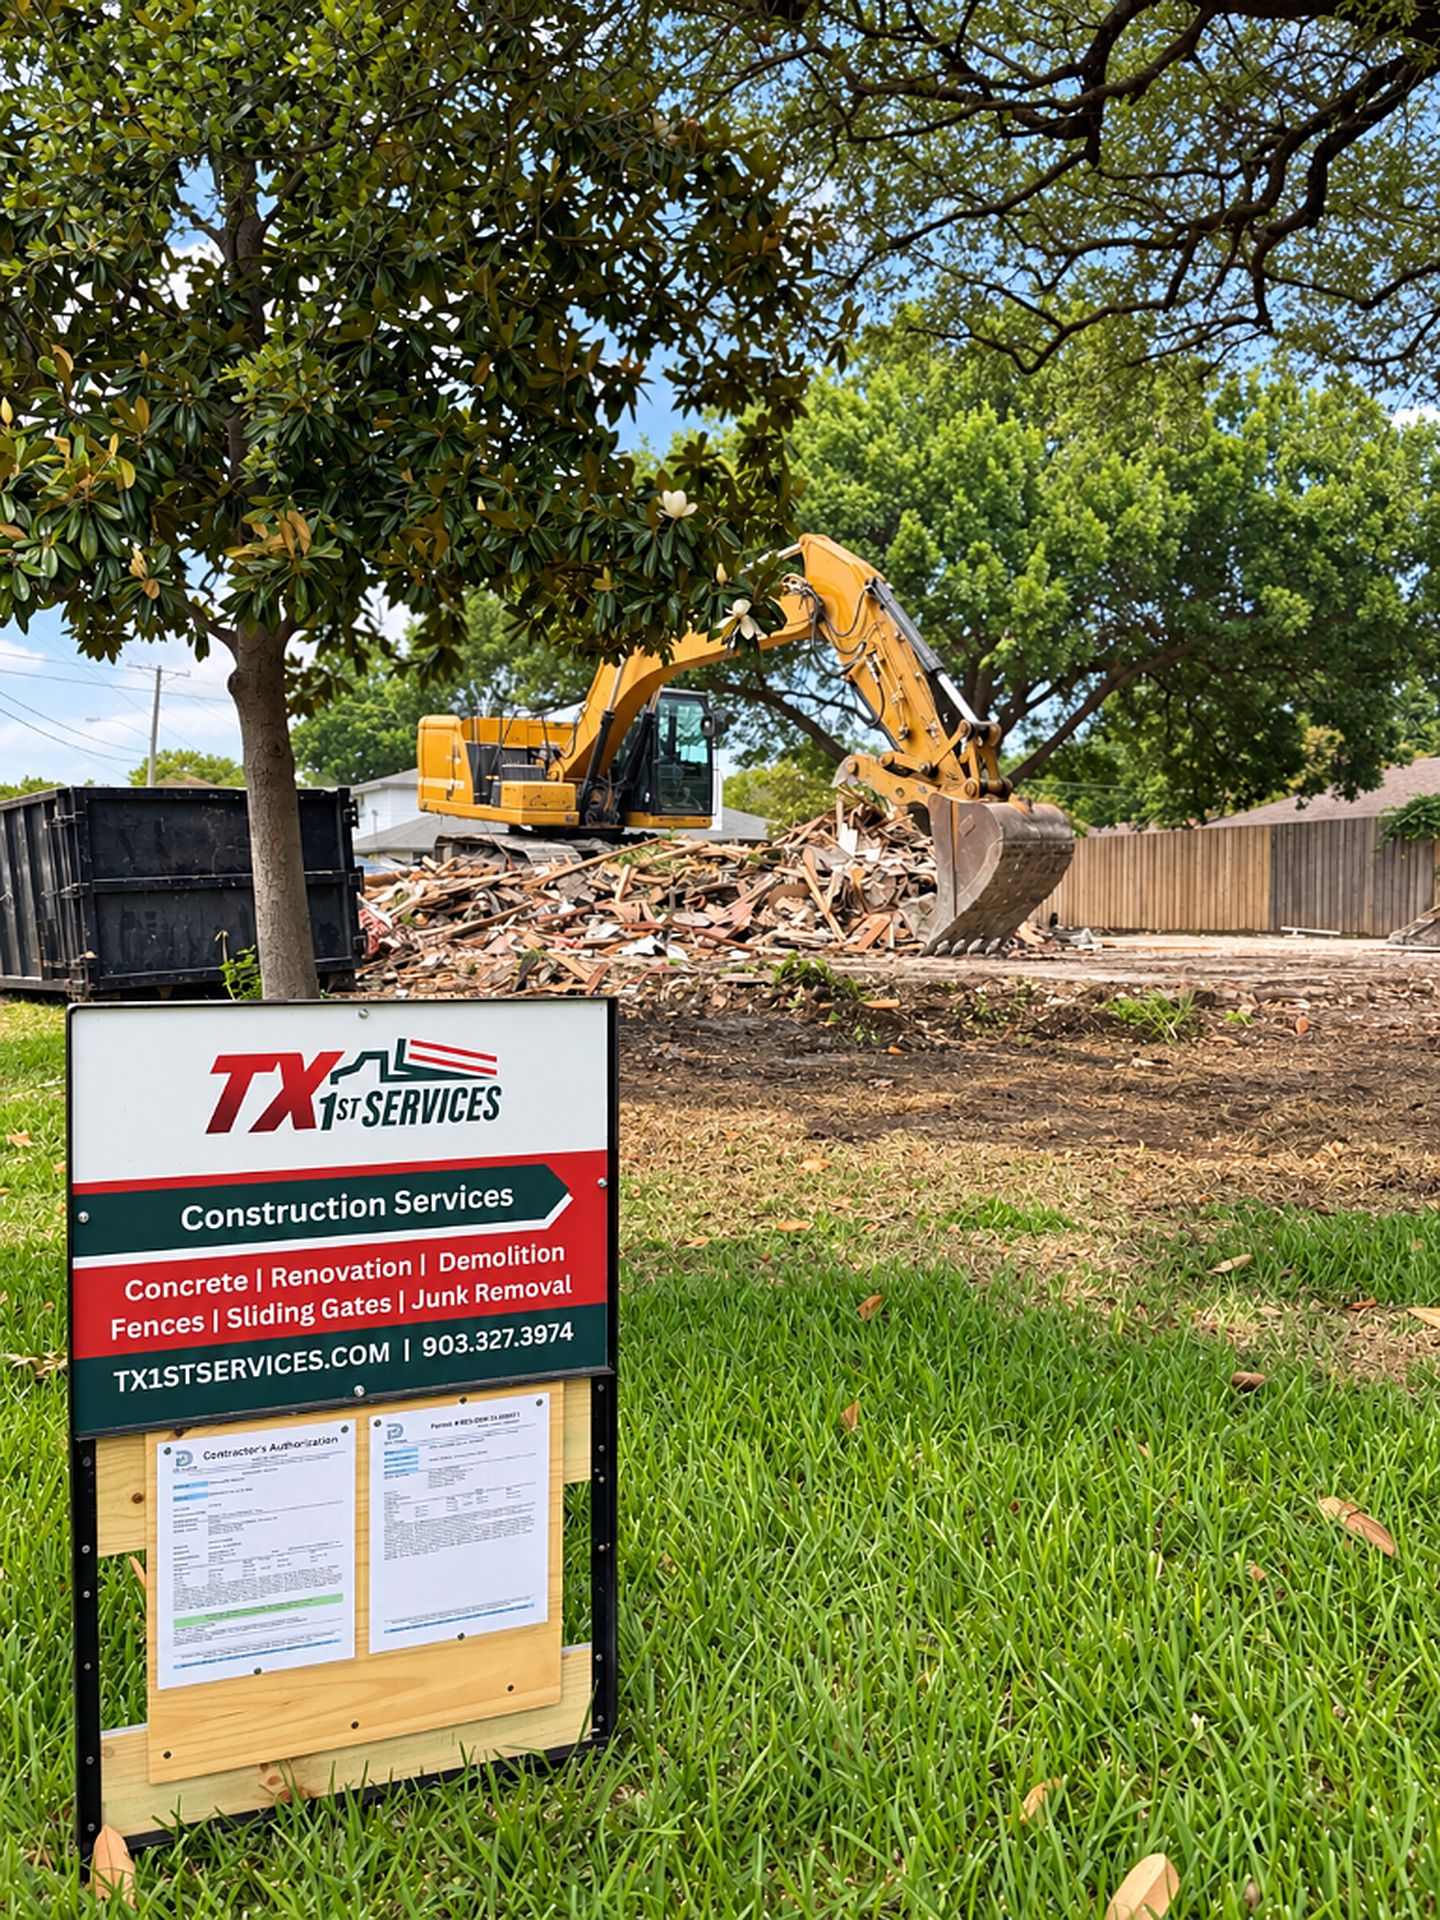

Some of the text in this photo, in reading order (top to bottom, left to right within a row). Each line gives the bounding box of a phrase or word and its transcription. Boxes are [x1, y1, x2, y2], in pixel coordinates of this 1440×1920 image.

[205, 1051, 345, 1134] TX
[361, 1085, 502, 1128] SERVICES
[180, 1184, 514, 1231] Construction Services
[125, 1273, 248, 1301] Concrete
[271, 1258, 412, 1288] Renovation
[439, 1243, 565, 1272] Demolition
[111, 1315, 204, 1341] Fences
[226, 1302, 316, 1327] Sliding
[321, 1296, 392, 1319] Gates
[411, 1285, 469, 1310] Junk
[475, 1274, 572, 1303] Removal
[113, 1342, 390, 1392] TX1STSERVICES.COM
[422, 1321, 574, 1357] 903.327.3974
[203, 1444, 267, 1461] Contractor's
[269, 1436, 339, 1452] Authorization
